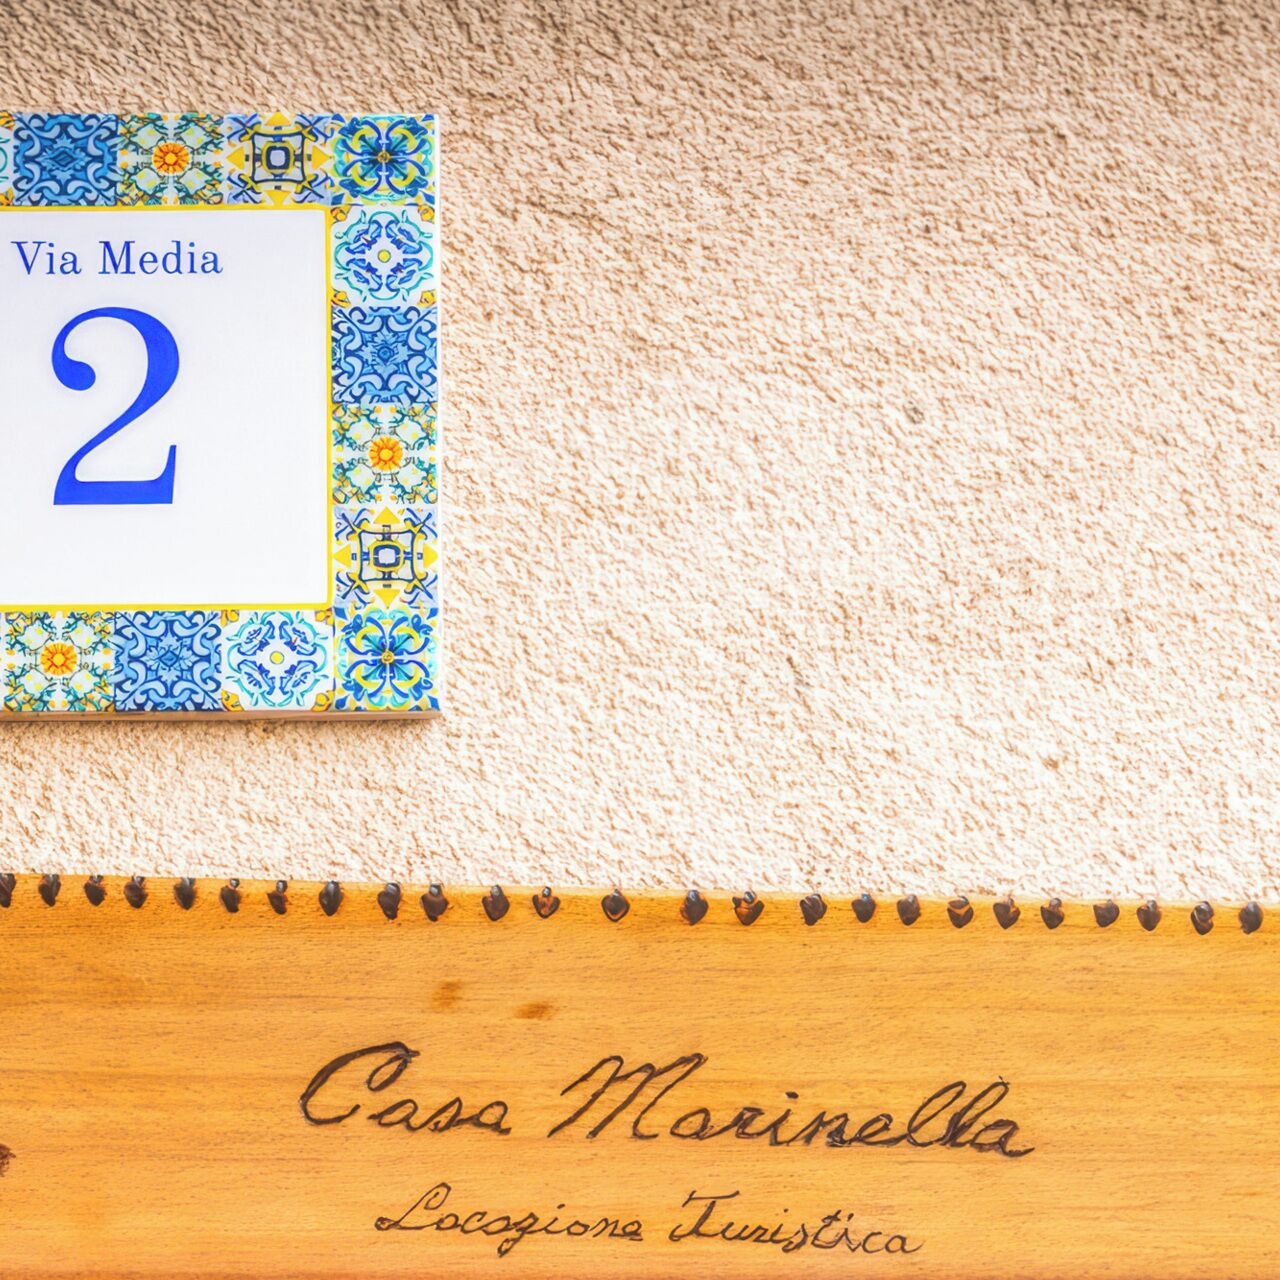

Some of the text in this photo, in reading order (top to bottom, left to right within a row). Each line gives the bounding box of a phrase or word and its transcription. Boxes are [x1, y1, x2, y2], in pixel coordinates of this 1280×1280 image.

[10, 240, 224, 276] Via Media
[51, 306, 180, 505] 2
[299, 1041, 1035, 1157] Casa Marinella
[375, 1182, 923, 1257] Locazione Turistica
